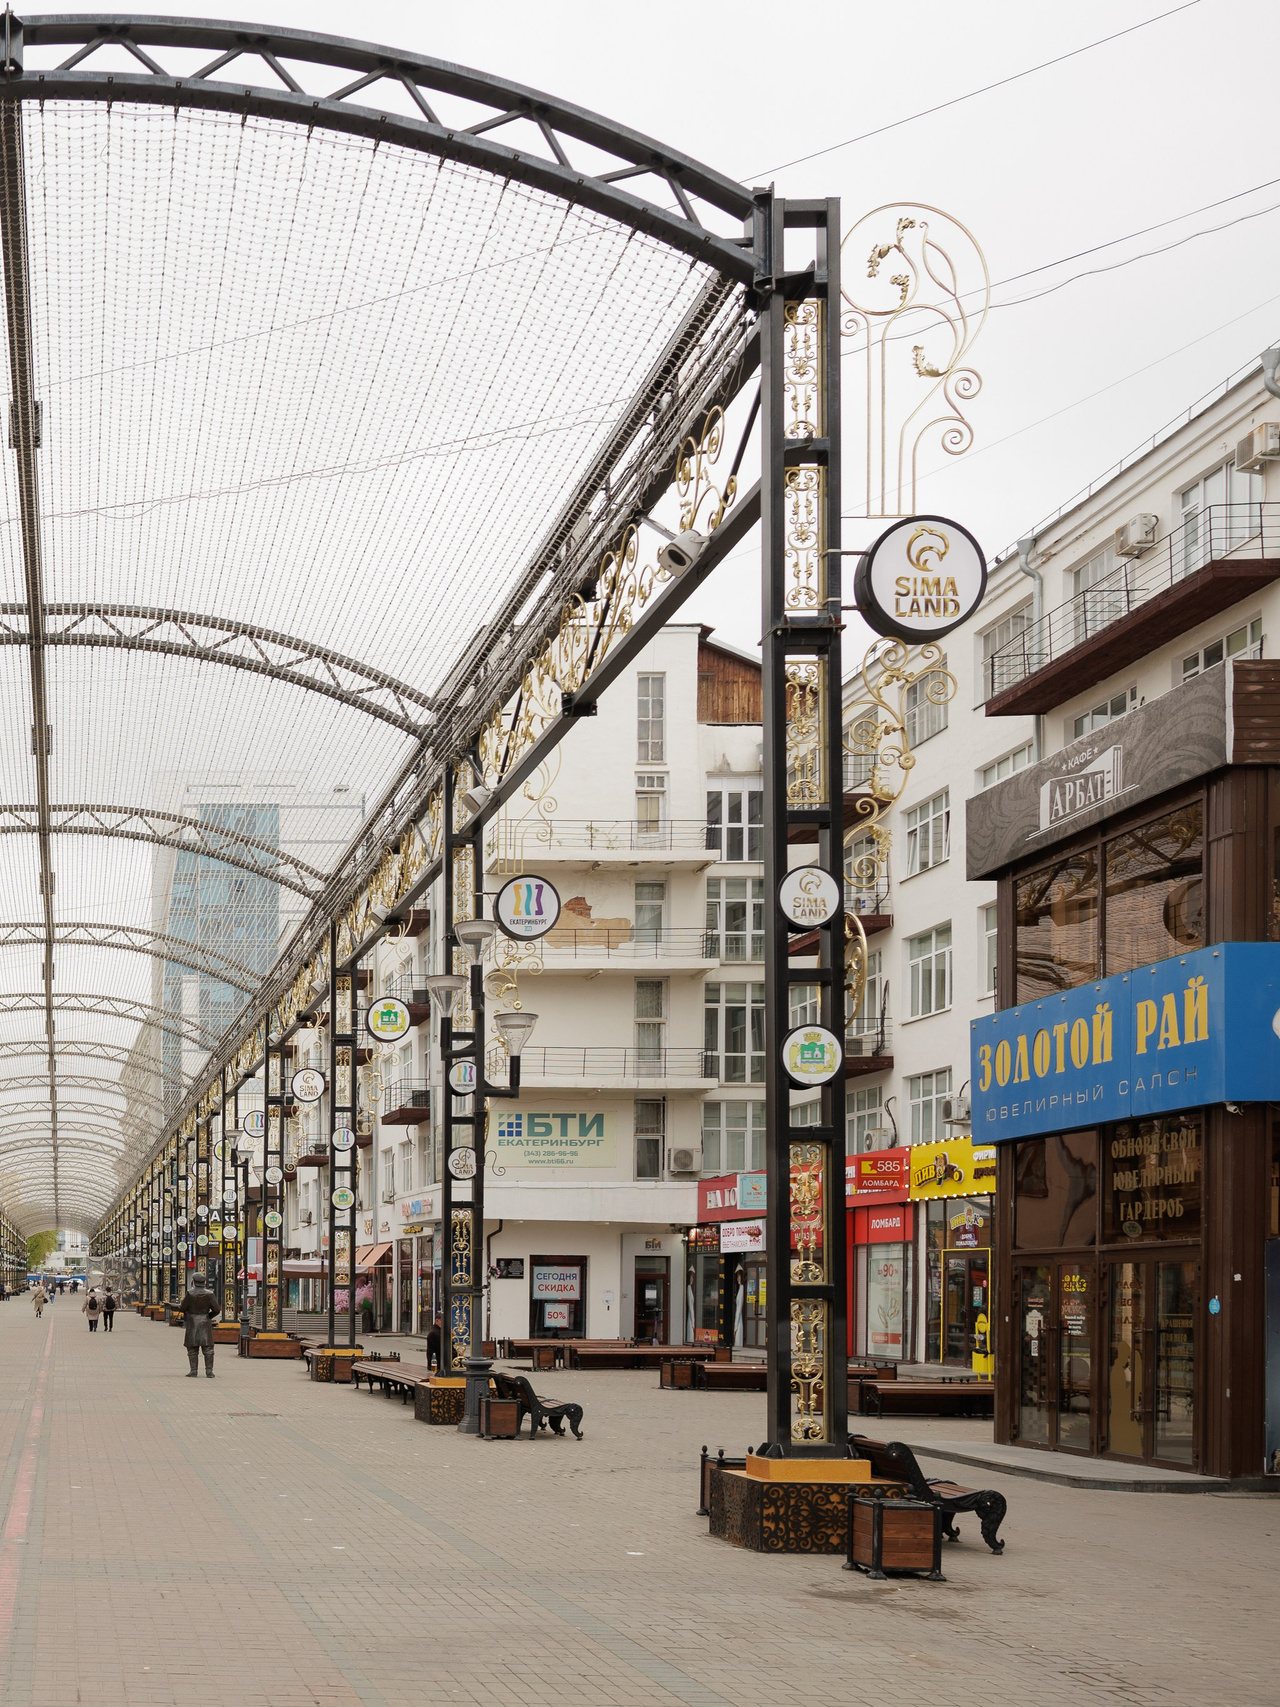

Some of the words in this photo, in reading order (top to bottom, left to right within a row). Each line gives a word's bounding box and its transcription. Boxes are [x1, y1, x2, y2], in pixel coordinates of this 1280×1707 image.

[894, 576, 959, 597] SIMA
[895, 597, 960, 618] LAND
[1068, 747, 1092, 770] КАФЕ
[1050, 773, 1104, 821] АРБАТ
[792, 896, 827, 908] SIMA
[509, 918, 548, 926] ЕКАТЕРИНБУРГ
[792, 908, 828, 919] LAND
[979, 1002, 1113, 1092] ЗОЛОТОЙ
[1136, 975, 1210, 1055] РАЙ
[986, 1085, 1104, 1122] ЮВЕЛИРНЫЙ
[1118, 1065, 1198, 1095] САЛОН
[527, 1113, 605, 1138] БТИ
[498, 1139, 605, 1147] ЕКАТЕРИНБУРГ
[1111, 1132, 1160, 1159] ОБНОВИ
[1162, 1123, 1196, 1151] СВОЙ
[877, 1161, 901, 1172] 585
[1113, 1158, 1195, 1191] ЮВЕЛИРНЫЙ
[914, 1165, 936, 1187] ПИВ
[1120, 1198, 1184, 1221] ГАРДЕРОБ
[871, 1218, 901, 1229] ЛОМБАРД
[645, 1241, 662, 1249] БТИ
[536, 1272, 578, 1282] СЕГОДНЯ
[883, 1263, 899, 1277] 90%
[537, 1283, 576, 1293] СКИДКА
[547, 1311, 566, 1320] 50%
